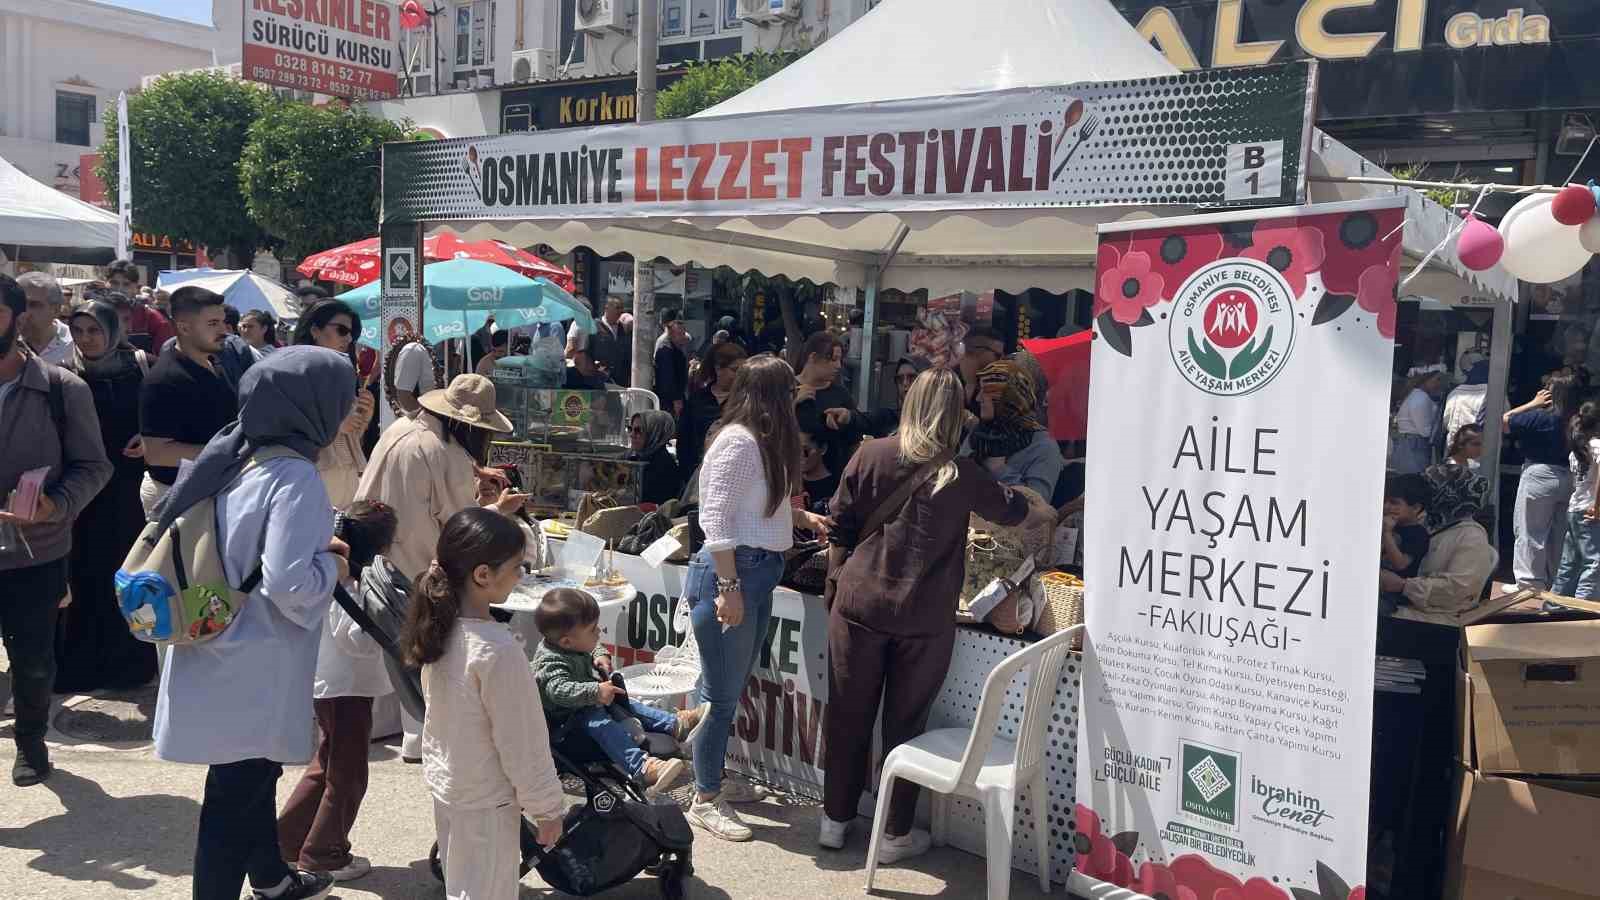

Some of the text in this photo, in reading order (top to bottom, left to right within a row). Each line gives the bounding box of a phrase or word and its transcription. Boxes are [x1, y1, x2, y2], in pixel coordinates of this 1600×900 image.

[253, 18, 391, 69] SÜRÜCÜ KURSU
[1445, 8, 1551, 48] Gıda
[275, 53, 372, 84] 0328 814 52 77
[559, 91, 637, 124] Korkm
[482, 119, 1053, 206] OSMANİYE LEZZET FESTİVALİ
[1244, 146, 1265, 170] B
[1246, 172, 1259, 195] 1
[1184, 270, 1281, 317] OSMANİYE BELEDİYESİ
[1179, 349, 1280, 391] AİLE YAŞAM MERKEZİ
[1172, 415, 1279, 475] AİLE
[1142, 485, 1307, 549] YAŞAM
[1119, 546, 1330, 619] MERKEZİ
[1183, 659, 1195, 669] Tel
[1208, 650, 1235, 664] Kursu,
[1303, 668, 1335, 683] Kursu,
[1154, 667, 1181, 680] Çocuk
[1183, 672, 1206, 687] Oyun
[1235, 683, 1265, 699] Kursu,
[1313, 700, 1345, 716] Kursu,
[1245, 715, 1272, 730] Yapay
[1135, 754, 1161, 773] KADIN
[1312, 744, 1342, 761] Kursu
[1104, 762, 1161, 792] GÜÇLÜ AİLE
[1252, 774, 1320, 811] İbrahim
[1160, 828, 1189, 846] ÇALIŞAN
